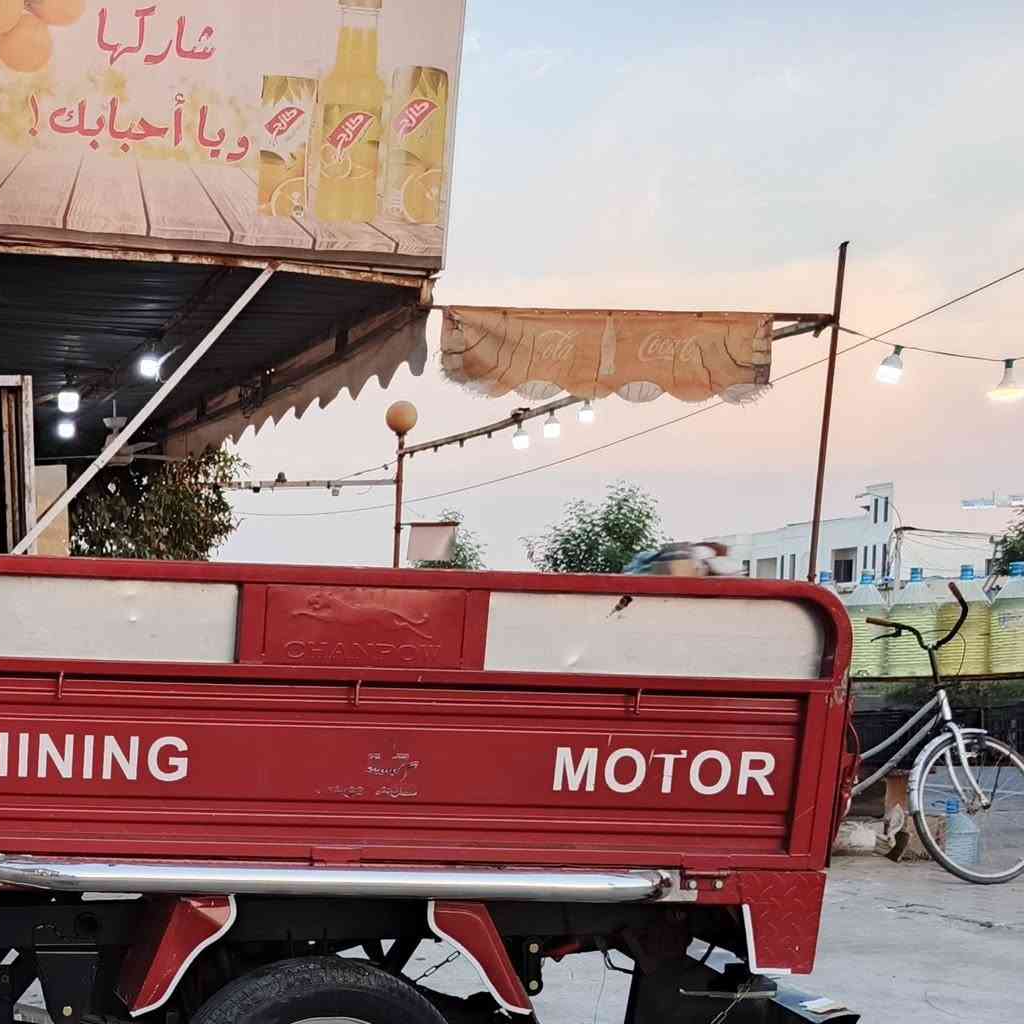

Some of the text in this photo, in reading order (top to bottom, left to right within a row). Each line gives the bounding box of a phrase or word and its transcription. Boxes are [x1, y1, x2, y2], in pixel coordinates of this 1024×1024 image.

[96, 7, 216, 66] شاركها
[197, 104, 252, 161] ويا
[552, 746, 776, 796] MOTOR
